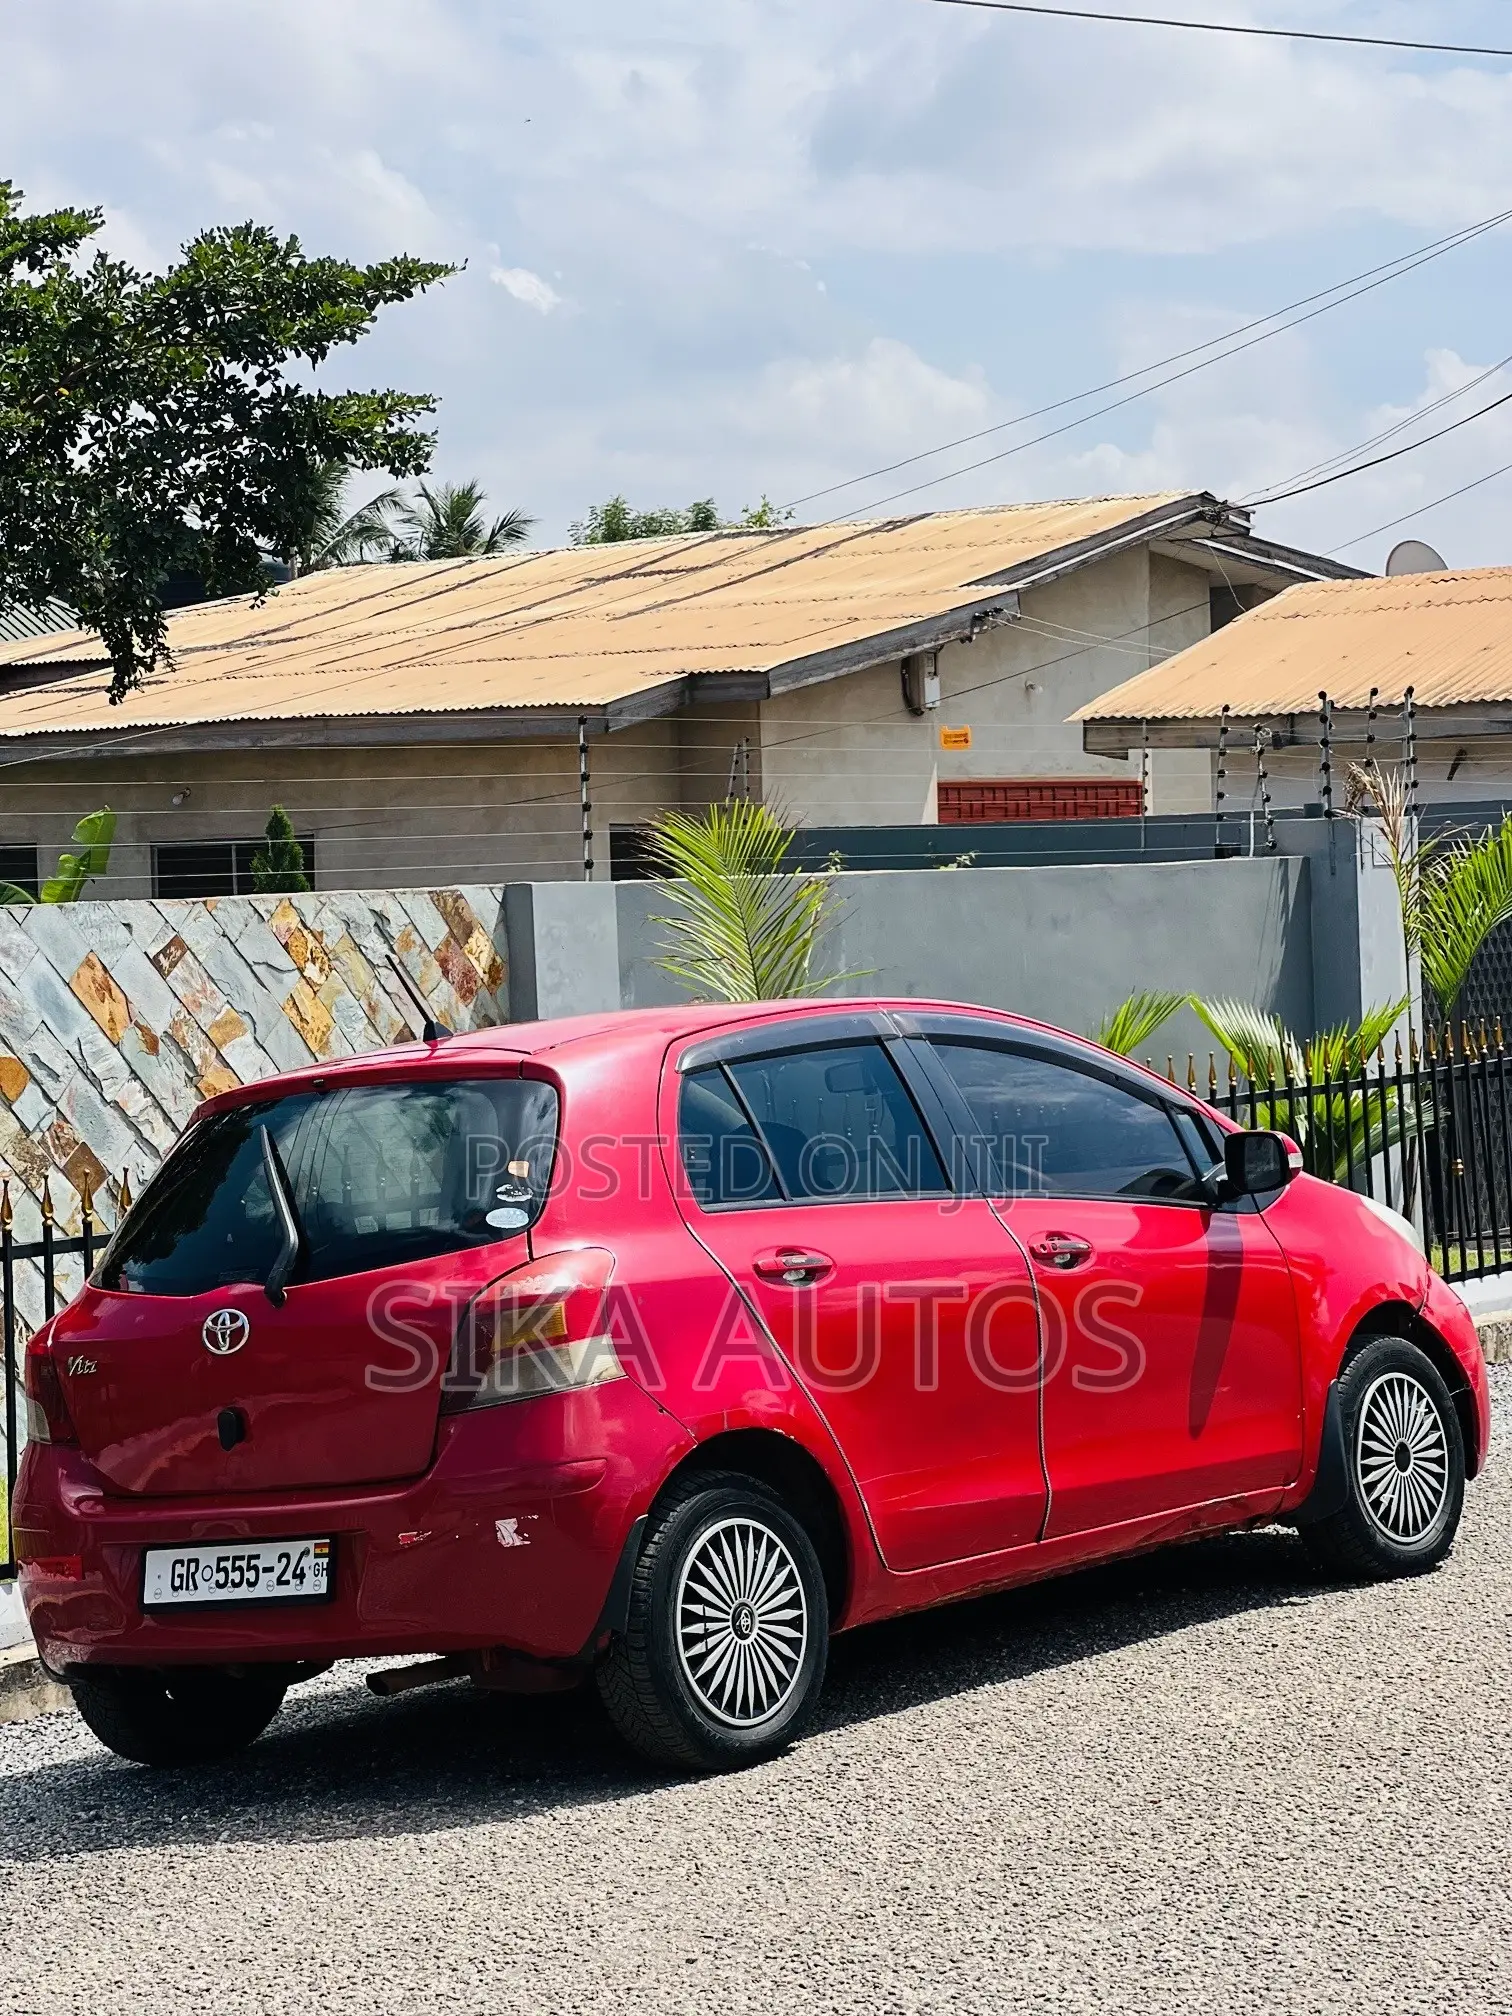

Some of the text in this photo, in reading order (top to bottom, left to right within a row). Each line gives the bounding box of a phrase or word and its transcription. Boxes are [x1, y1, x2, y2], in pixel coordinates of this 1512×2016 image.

[170, 1548, 308, 1592] GR 555-24
[313, 1561, 329, 1578] GH
